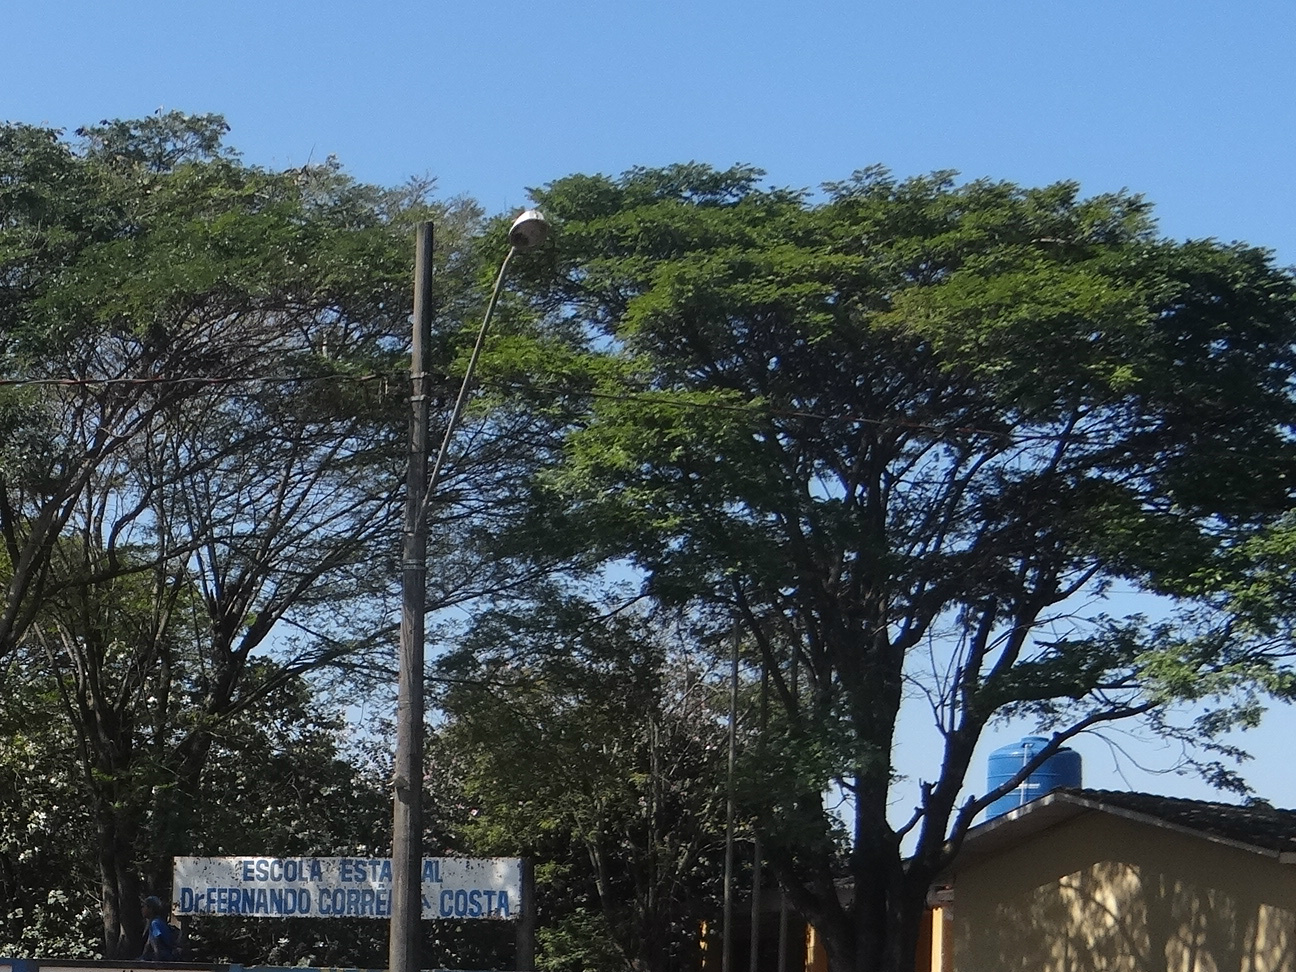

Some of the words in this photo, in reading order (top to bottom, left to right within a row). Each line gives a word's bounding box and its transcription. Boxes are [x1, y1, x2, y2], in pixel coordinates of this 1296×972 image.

[242, 859, 323, 883] ESCOLA
[340, 859, 443, 883] ESTAAL
[439, 889, 510, 917] COSTA
